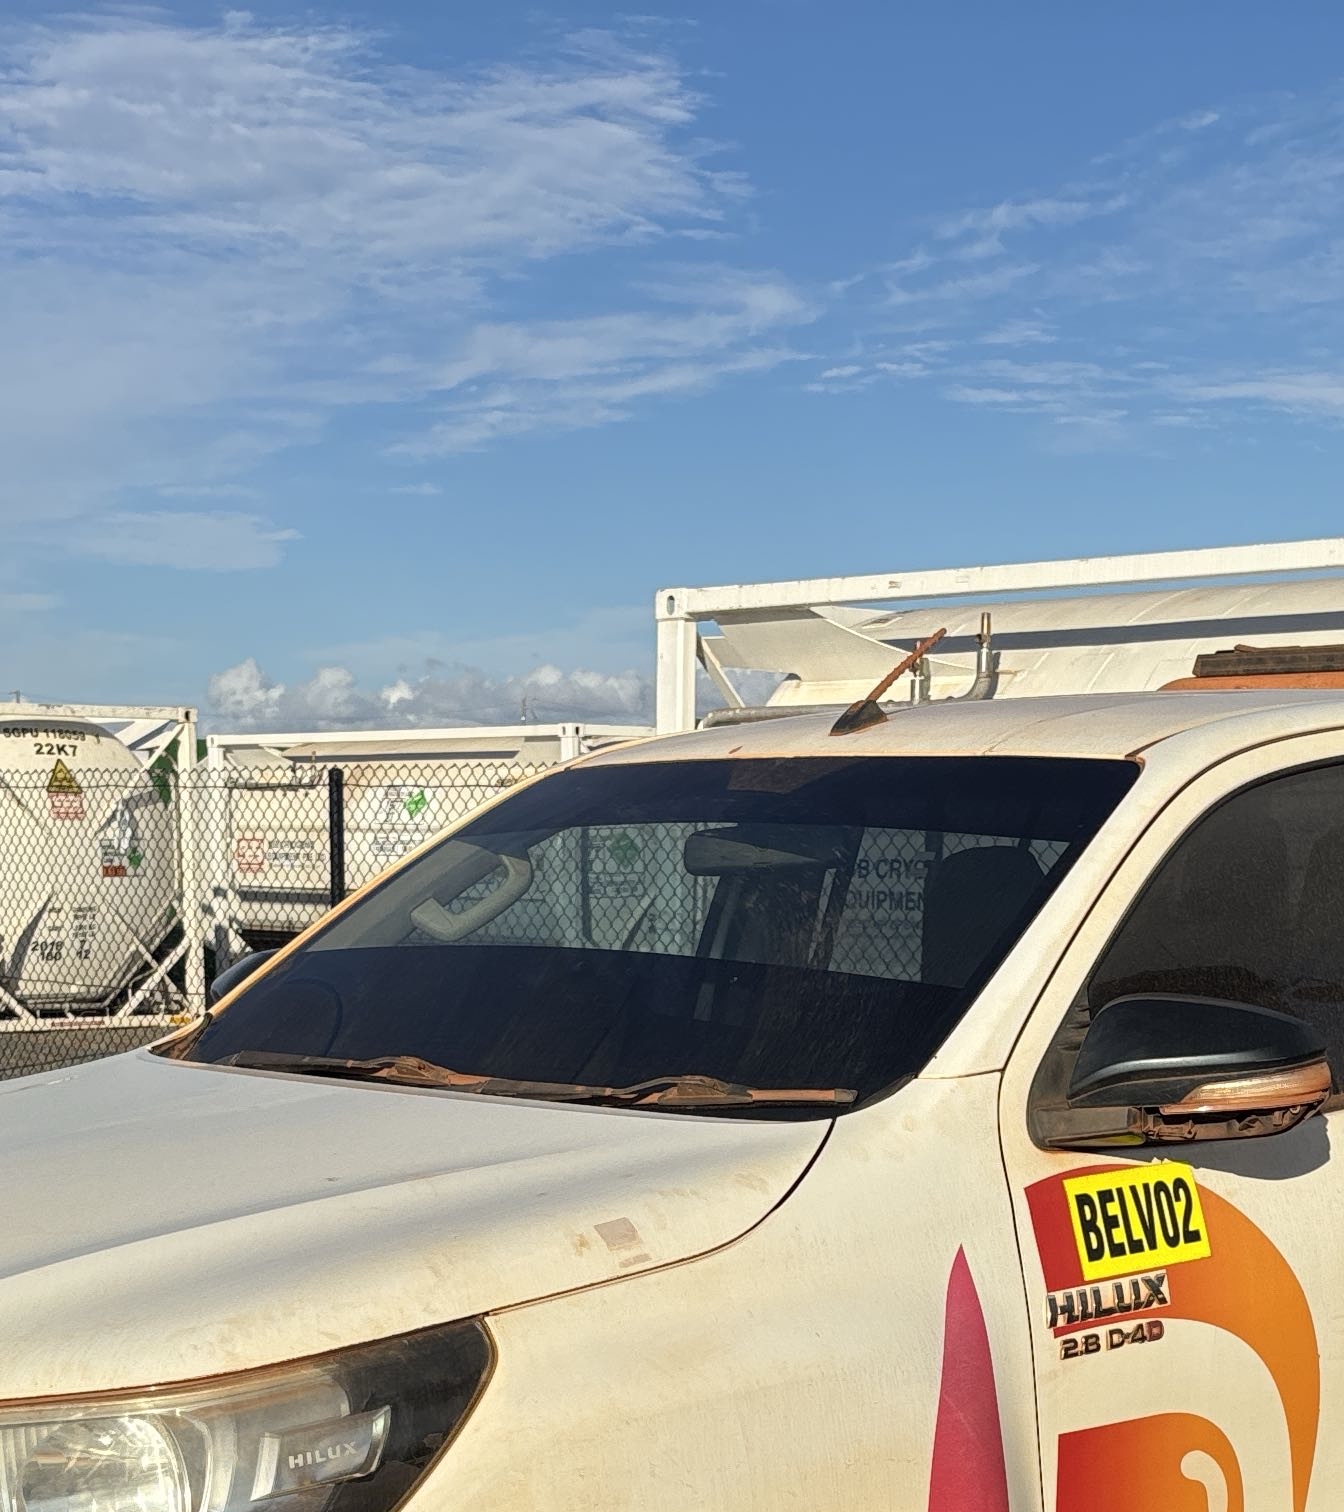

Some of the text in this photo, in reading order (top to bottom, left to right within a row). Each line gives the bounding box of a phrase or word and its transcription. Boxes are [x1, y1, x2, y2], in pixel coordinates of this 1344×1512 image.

[34, 742, 77, 757] 22K7
[1075, 1177, 1202, 1263] BELV02
[1046, 1273, 1169, 1328] HILUX
[1060, 1319, 1165, 1360] 2.8 D-4D
